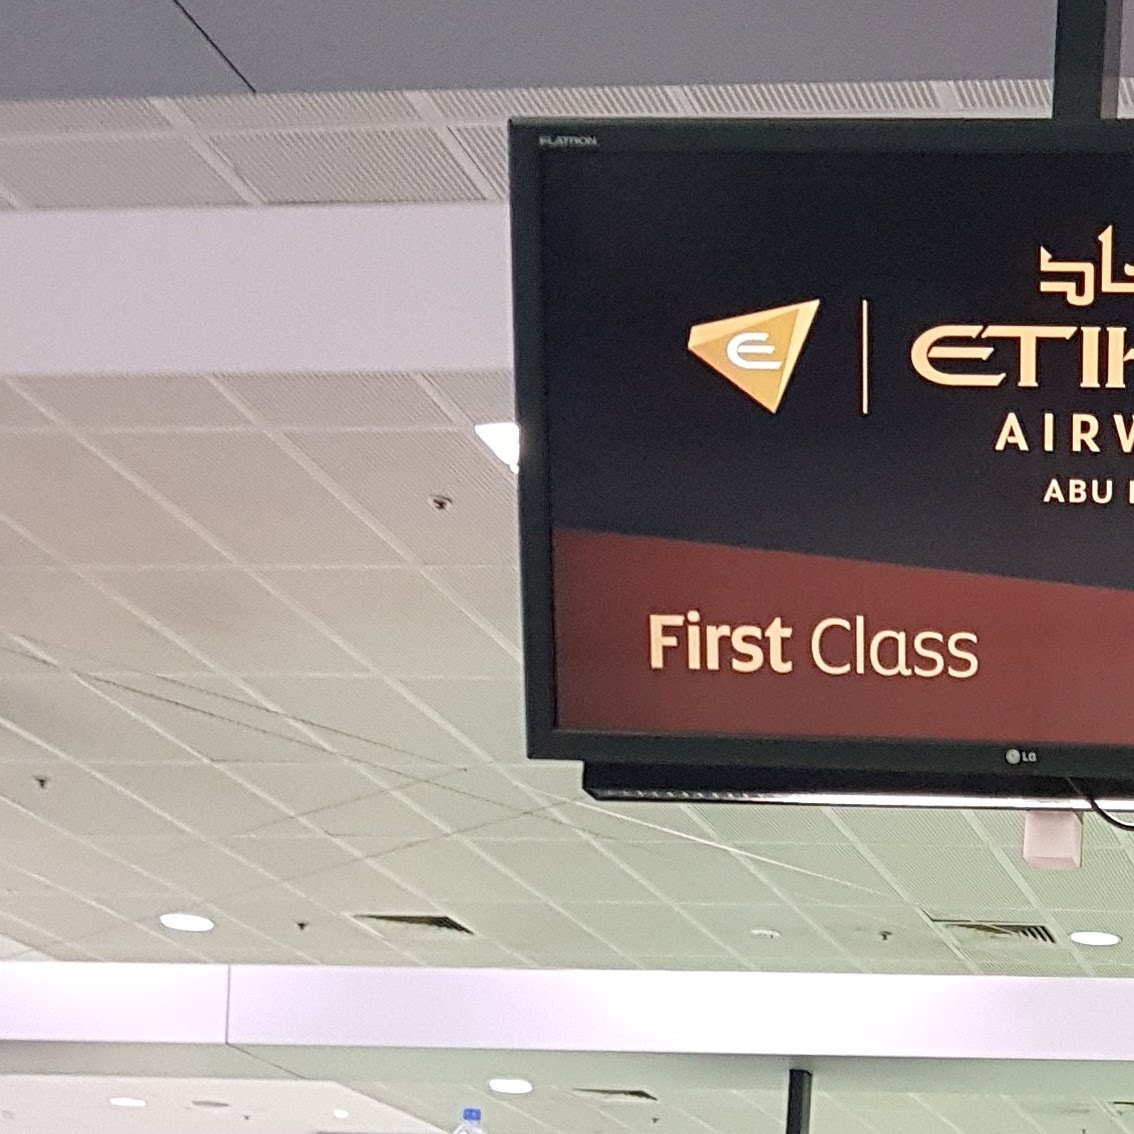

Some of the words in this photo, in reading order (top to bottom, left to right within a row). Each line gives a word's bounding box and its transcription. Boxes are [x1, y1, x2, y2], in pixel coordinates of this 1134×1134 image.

[538, 135, 598, 147] FLATRON
[1043, 478, 1113, 504] ABU
[649, 610, 793, 674] First
[811, 615, 979, 678] Class
